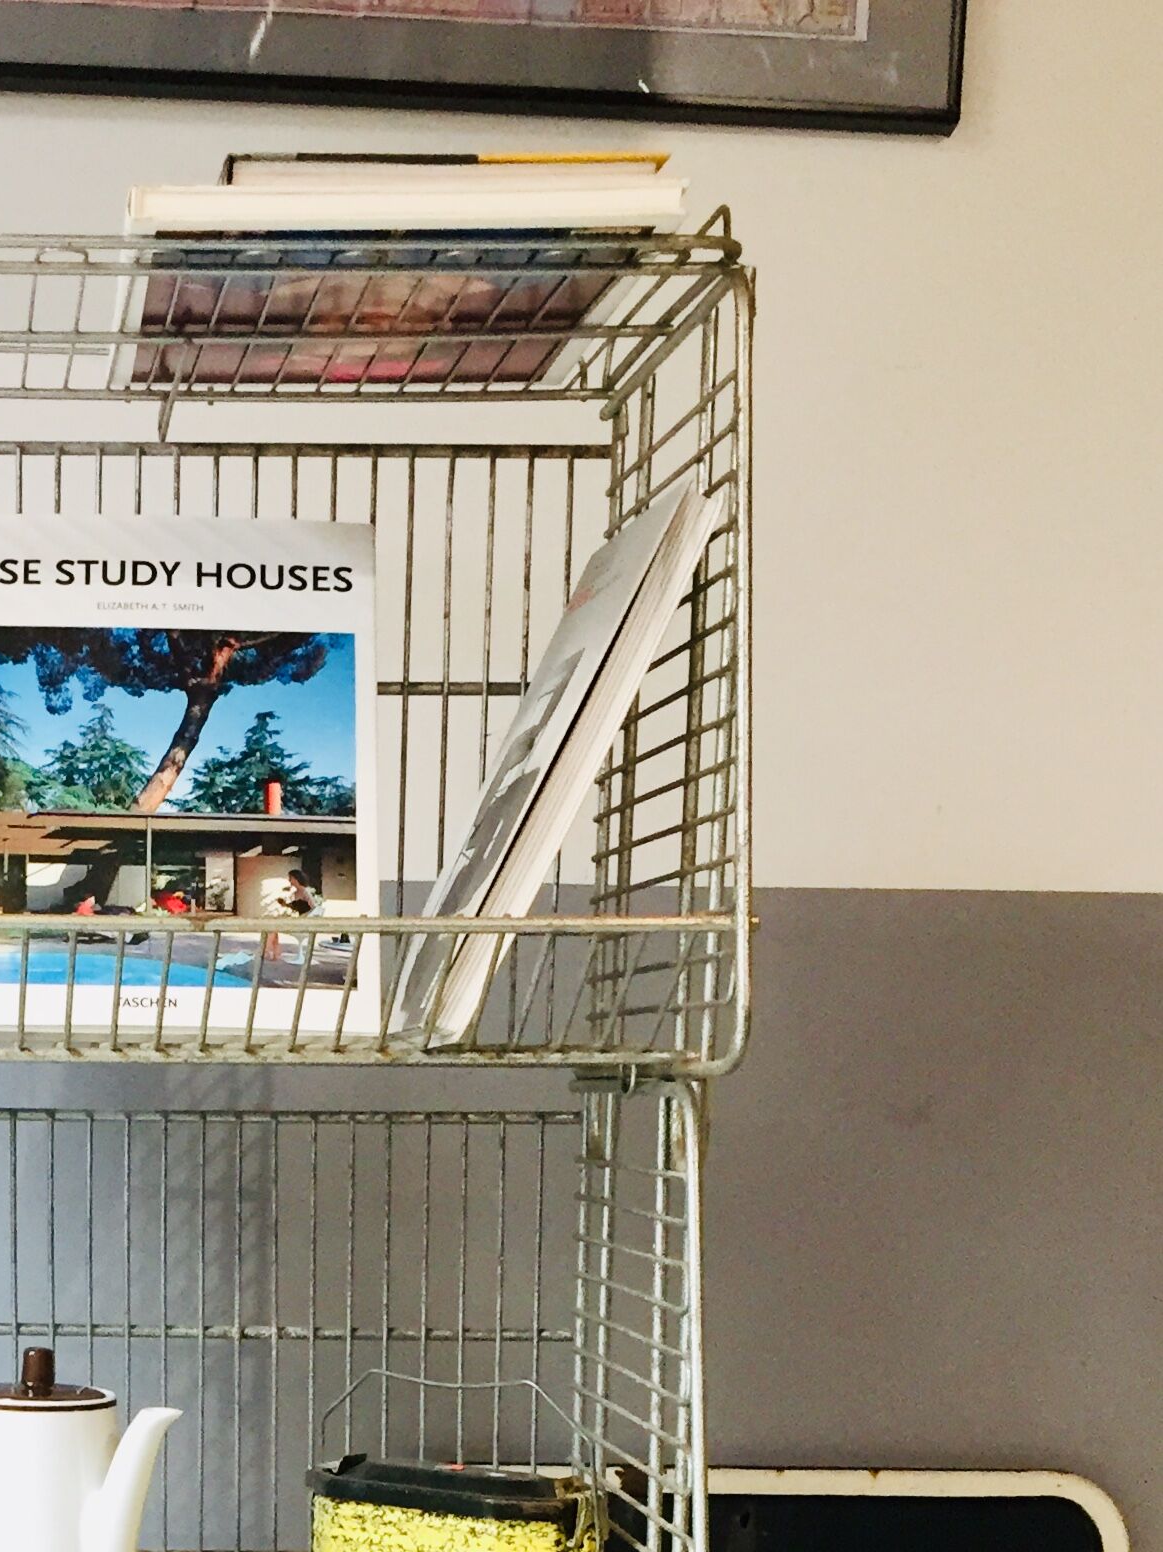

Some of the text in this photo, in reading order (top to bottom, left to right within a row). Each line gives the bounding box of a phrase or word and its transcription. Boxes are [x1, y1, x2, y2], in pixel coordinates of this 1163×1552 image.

[55, 559, 181, 587] STUDY
[196, 561, 354, 592] HOUSES
[97, 601, 148, 610] ELIZABETH
[173, 603, 204, 612] SMITH
